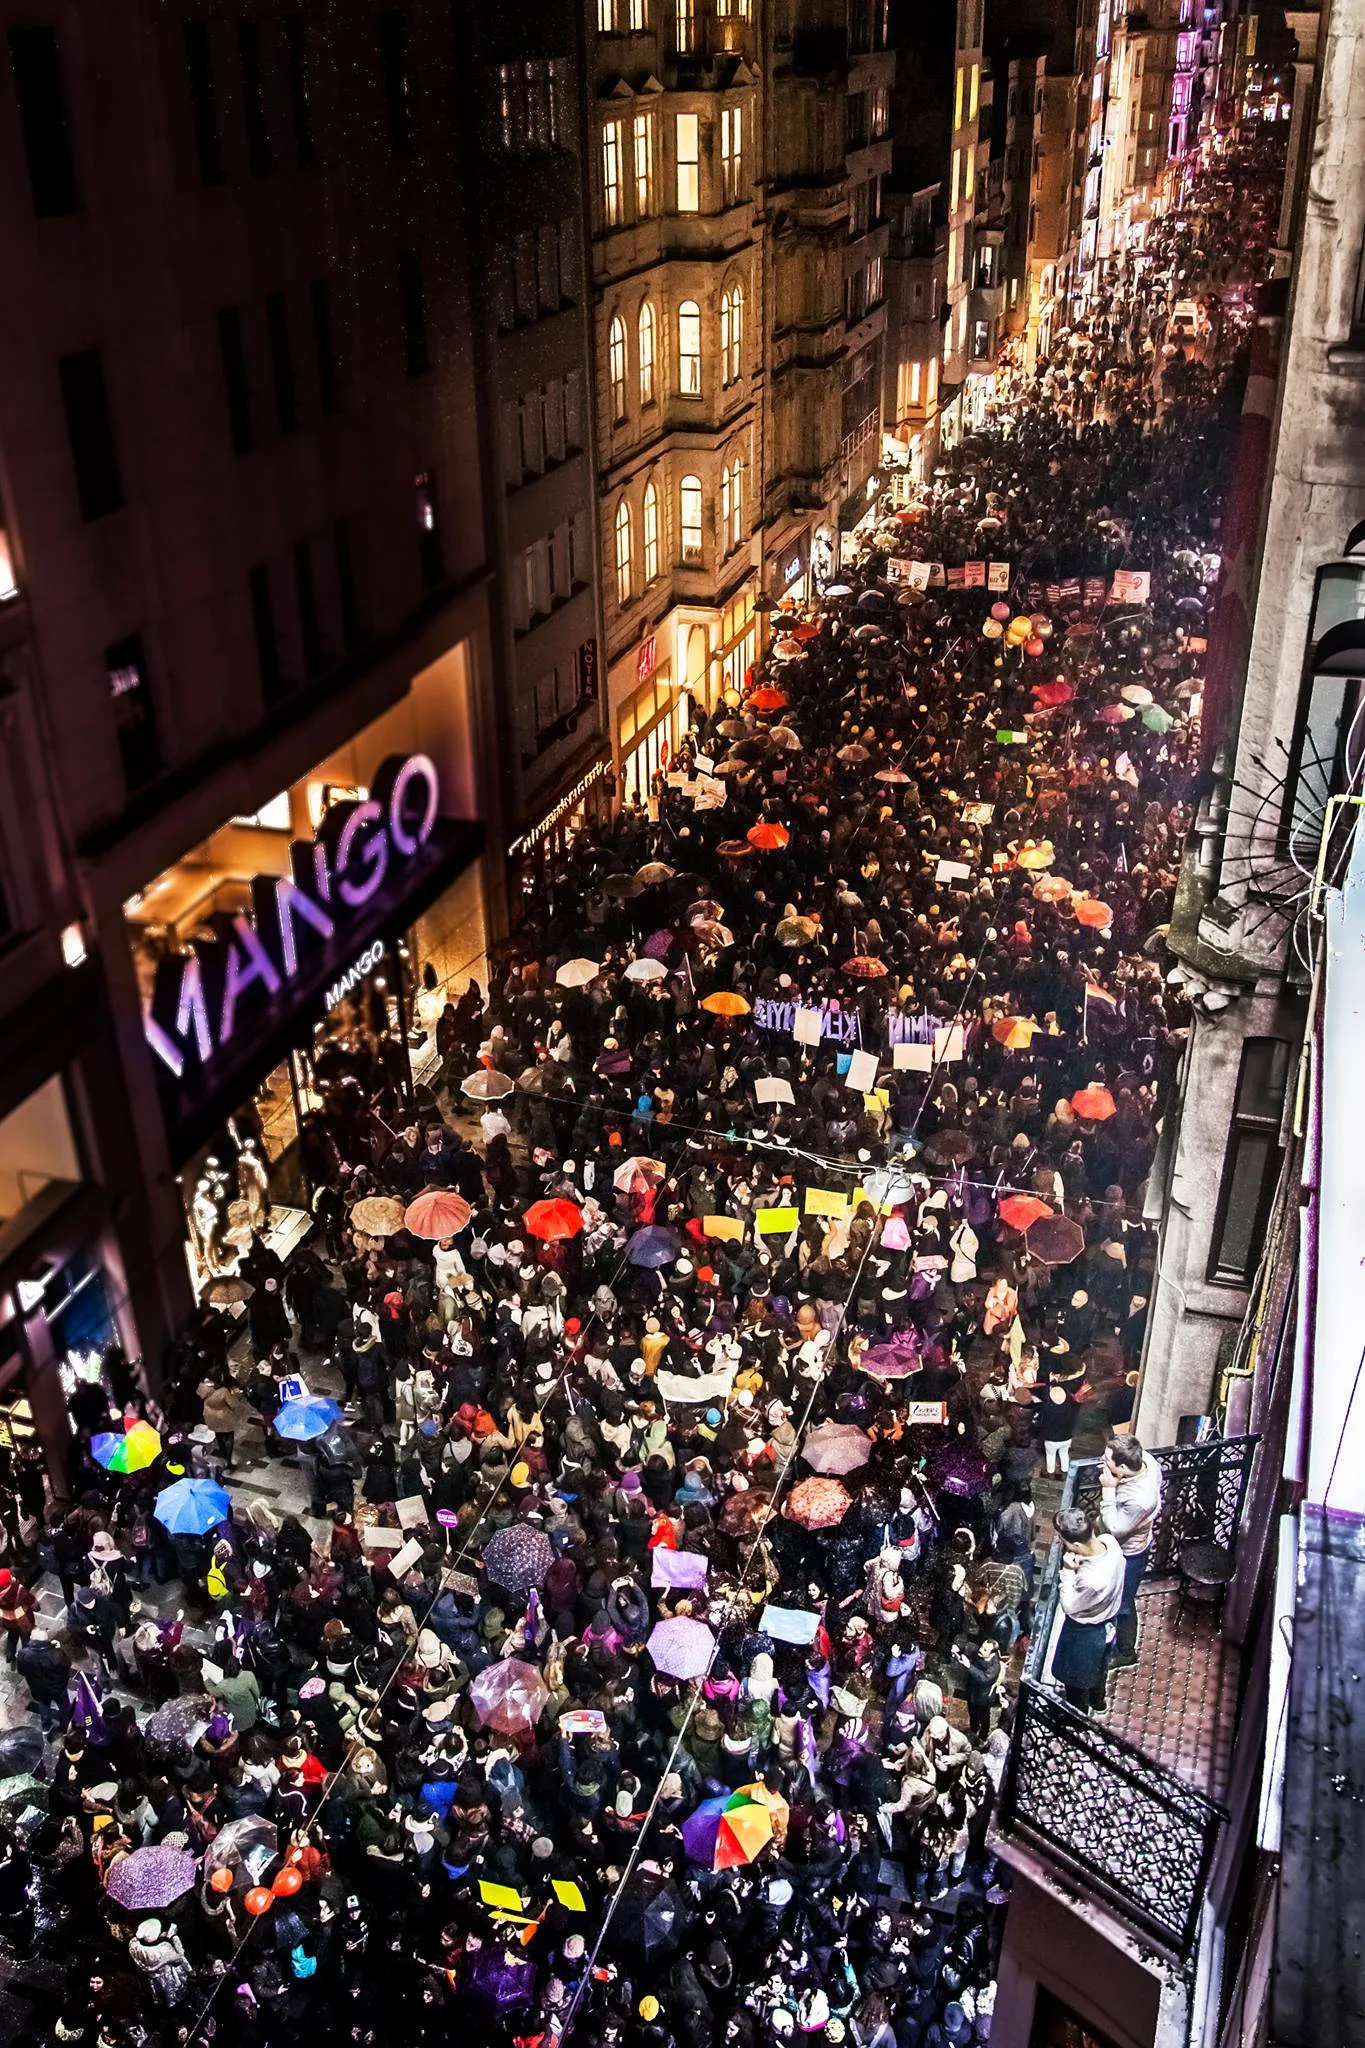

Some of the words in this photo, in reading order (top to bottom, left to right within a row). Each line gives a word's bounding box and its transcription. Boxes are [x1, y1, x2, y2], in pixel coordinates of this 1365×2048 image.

[583, 640, 594, 696] NOTER
[143, 753, 438, 1077] MANGO
[325, 940, 384, 1011] MANGO
